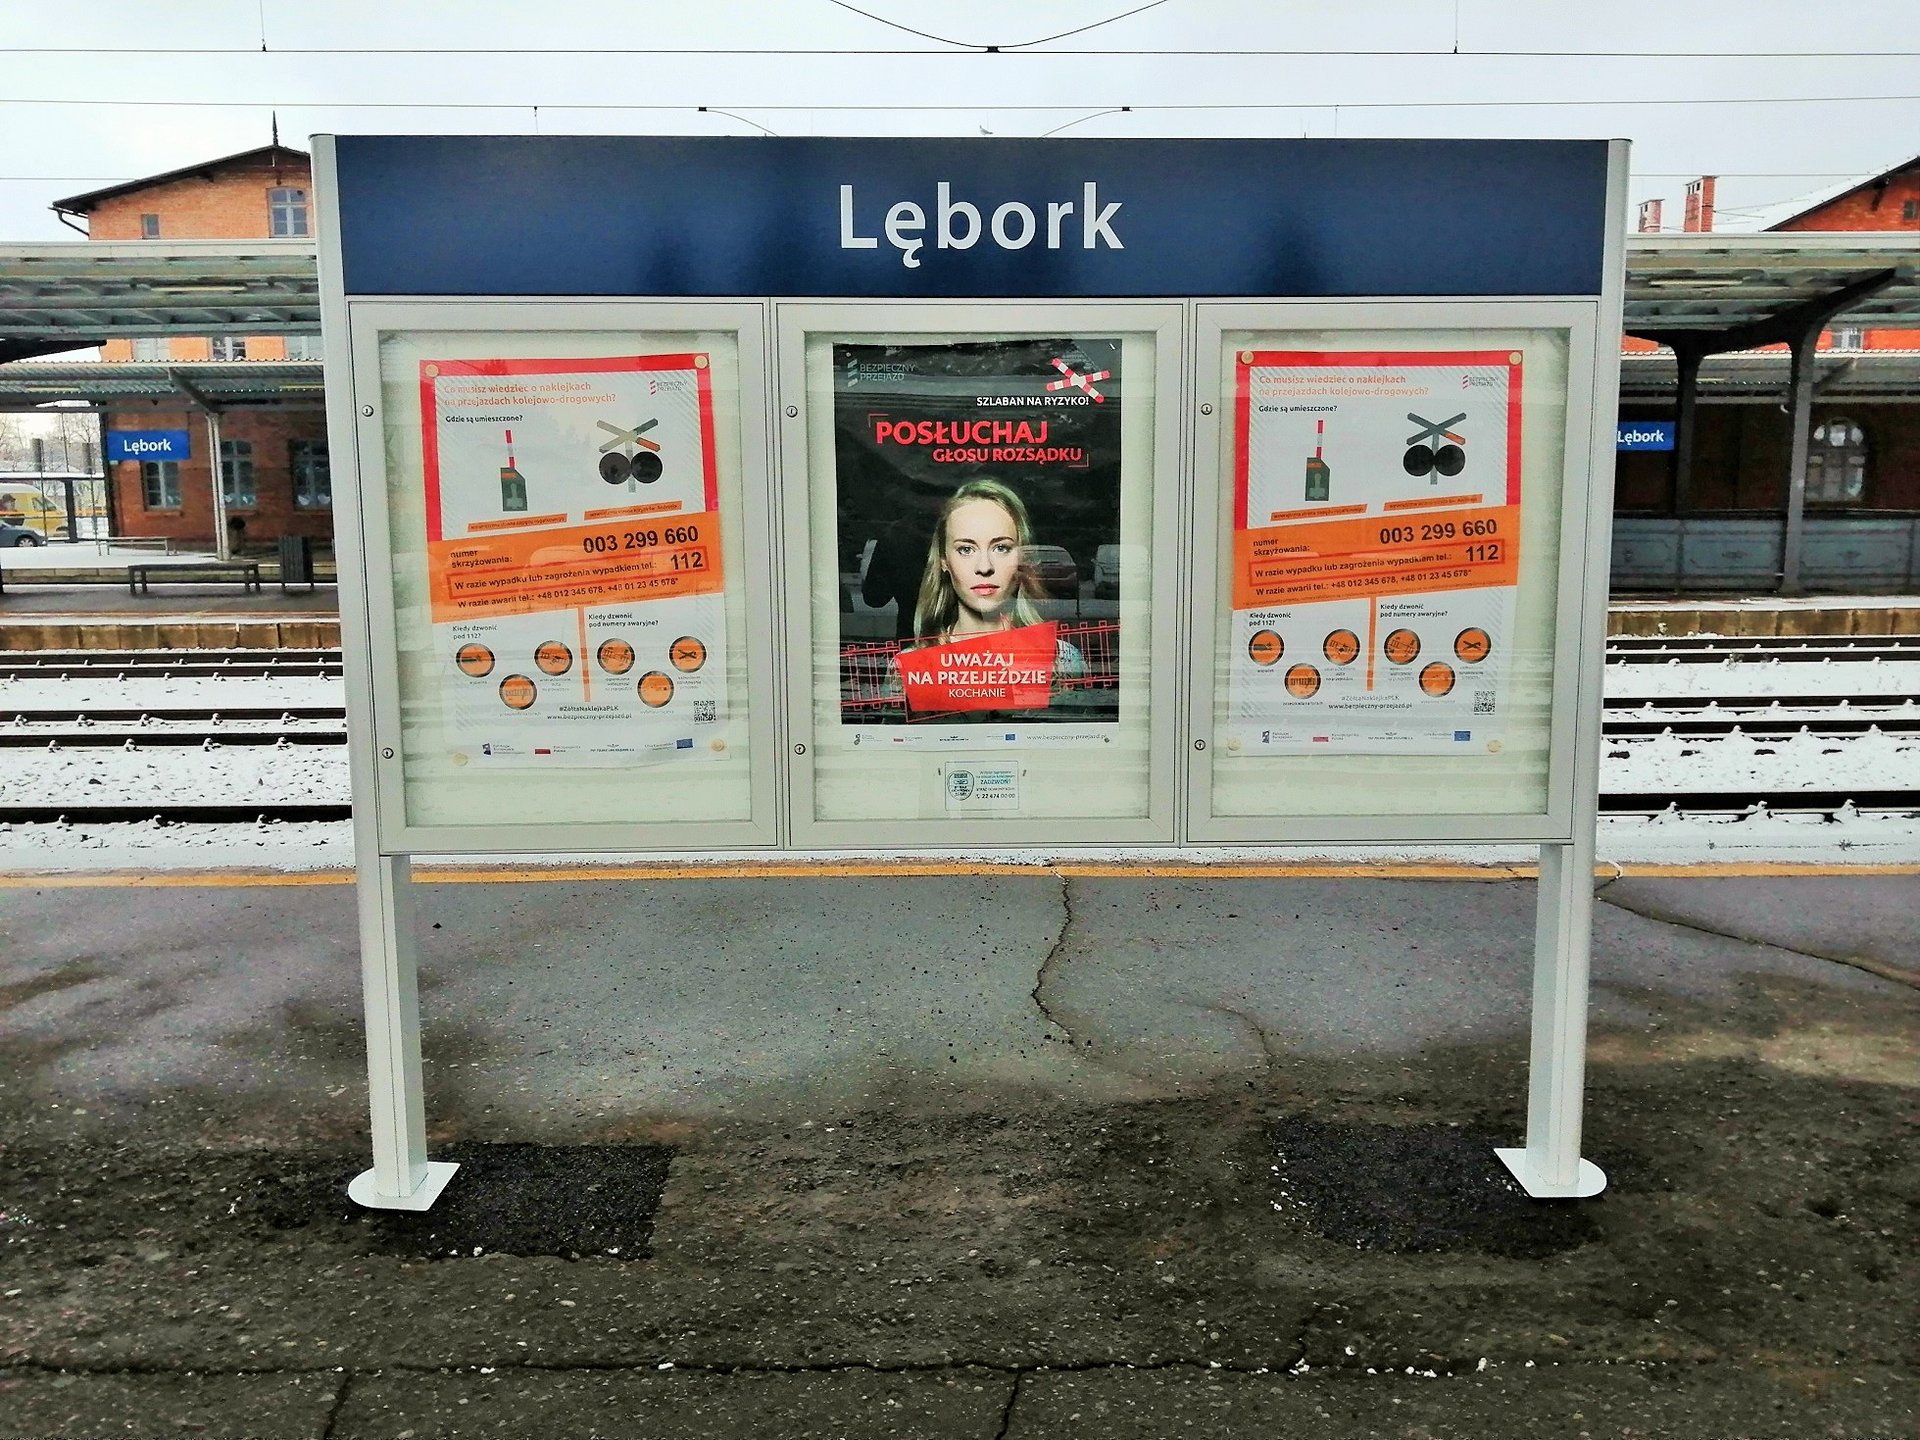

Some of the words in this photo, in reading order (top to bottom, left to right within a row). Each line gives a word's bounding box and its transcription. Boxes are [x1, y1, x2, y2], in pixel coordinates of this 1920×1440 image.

[840, 181, 1125, 268] Lębork
[859, 363, 916, 372] BEZPIECZNY
[859, 372, 905, 382] PRZEJAZD
[1259, 375, 1271, 384] Co
[1273, 375, 1305, 384] musisz
[1356, 375, 1406, 385] naklejkach
[457, 384, 487, 393] musisz
[539, 382, 591, 392] naklejkach
[1272, 386, 1327, 397] przejazdach
[1329, 386, 1429, 397] kolejowo-drogowych?
[458, 396, 511, 407] przejazdach
[513, 393, 616, 406] kolejowo-drogowych?
[976, 396, 1025, 406] SZLABAN
[1026, 396, 1042, 406] NA
[1044, 396, 1090, 406] RYZYKO!
[1258, 405, 1279, 413] Gdzie
[1280, 405, 1288, 413] są
[1289, 404, 1338, 412] umieszczone?
[445, 415, 465, 423] Gdzie
[466, 416, 474, 424] są
[474, 414, 523, 423] umieszczone?
[876, 420, 1048, 445] POSŁUCHAJ
[1617, 429, 1665, 446] Lębork
[123, 438, 172, 455] Lębork
[932, 447, 989, 463] GŁOSU
[992, 447, 1082, 465] ROZSĄDKU
[583, 534, 619, 553] 003
[623, 530, 659, 549] 299
[664, 525, 699, 544] 660
[1379, 526, 1414, 544] 003
[1421, 522, 1456, 541] 299
[1462, 518, 1497, 537] 660
[1253, 538, 1278, 547] numer
[1253, 544, 1310, 557] skrzyżowania:
[450, 549, 479, 559] numer
[451, 555, 513, 568] skrzyżowania:
[670, 551, 703, 570] 112
[1465, 544, 1499, 562] 112
[1255, 569, 1264, 577] W
[1265, 566, 1284, 576] razie
[1285, 564, 1323, 576] wypadku
[1324, 563, 1338, 571] lub
[1339, 558, 1385, 571] zagrożenia
[1386, 554, 1434, 567] wypadkiem
[454, 581, 464, 590] W
[466, 578, 487, 588] razie
[489, 575, 528, 587] wypadku
[529, 574, 543, 582] lub
[544, 567, 590, 581] zagrożenia
[592, 563, 640, 576] wypadkiem
[1256, 588, 1264, 596] W
[1265, 586, 1285, 595] razie
[1286, 583, 1312, 593] awarii
[1331, 580, 1346, 589] +48
[1347, 579, 1362, 587] 012
[1364, 577, 1379, 585] 345
[1381, 575, 1398, 584] 678,
[1400, 574, 1415, 582] +48
[1417, 573, 1427, 581] 01
[1429, 572, 1440, 580] 23
[1441, 570, 1452, 578] 45
[457, 600, 467, 608] W
[468, 598, 489, 608] razie
[491, 595, 517, 605] awarii
[537, 591, 552, 600] +48
[554, 589, 569, 598] 012
[571, 587, 586, 596] 345
[607, 583, 623, 591] +48
[624, 581, 634, 590] 01
[636, 580, 647, 589] 23
[649, 579, 659, 587] 45
[940, 649, 1015, 668] UWAŻAJ
[907, 671, 934, 685] NA
[937, 667, 1047, 685] PRZEJEŹDZIE
[948, 687, 1006, 698] KOCHANIE
